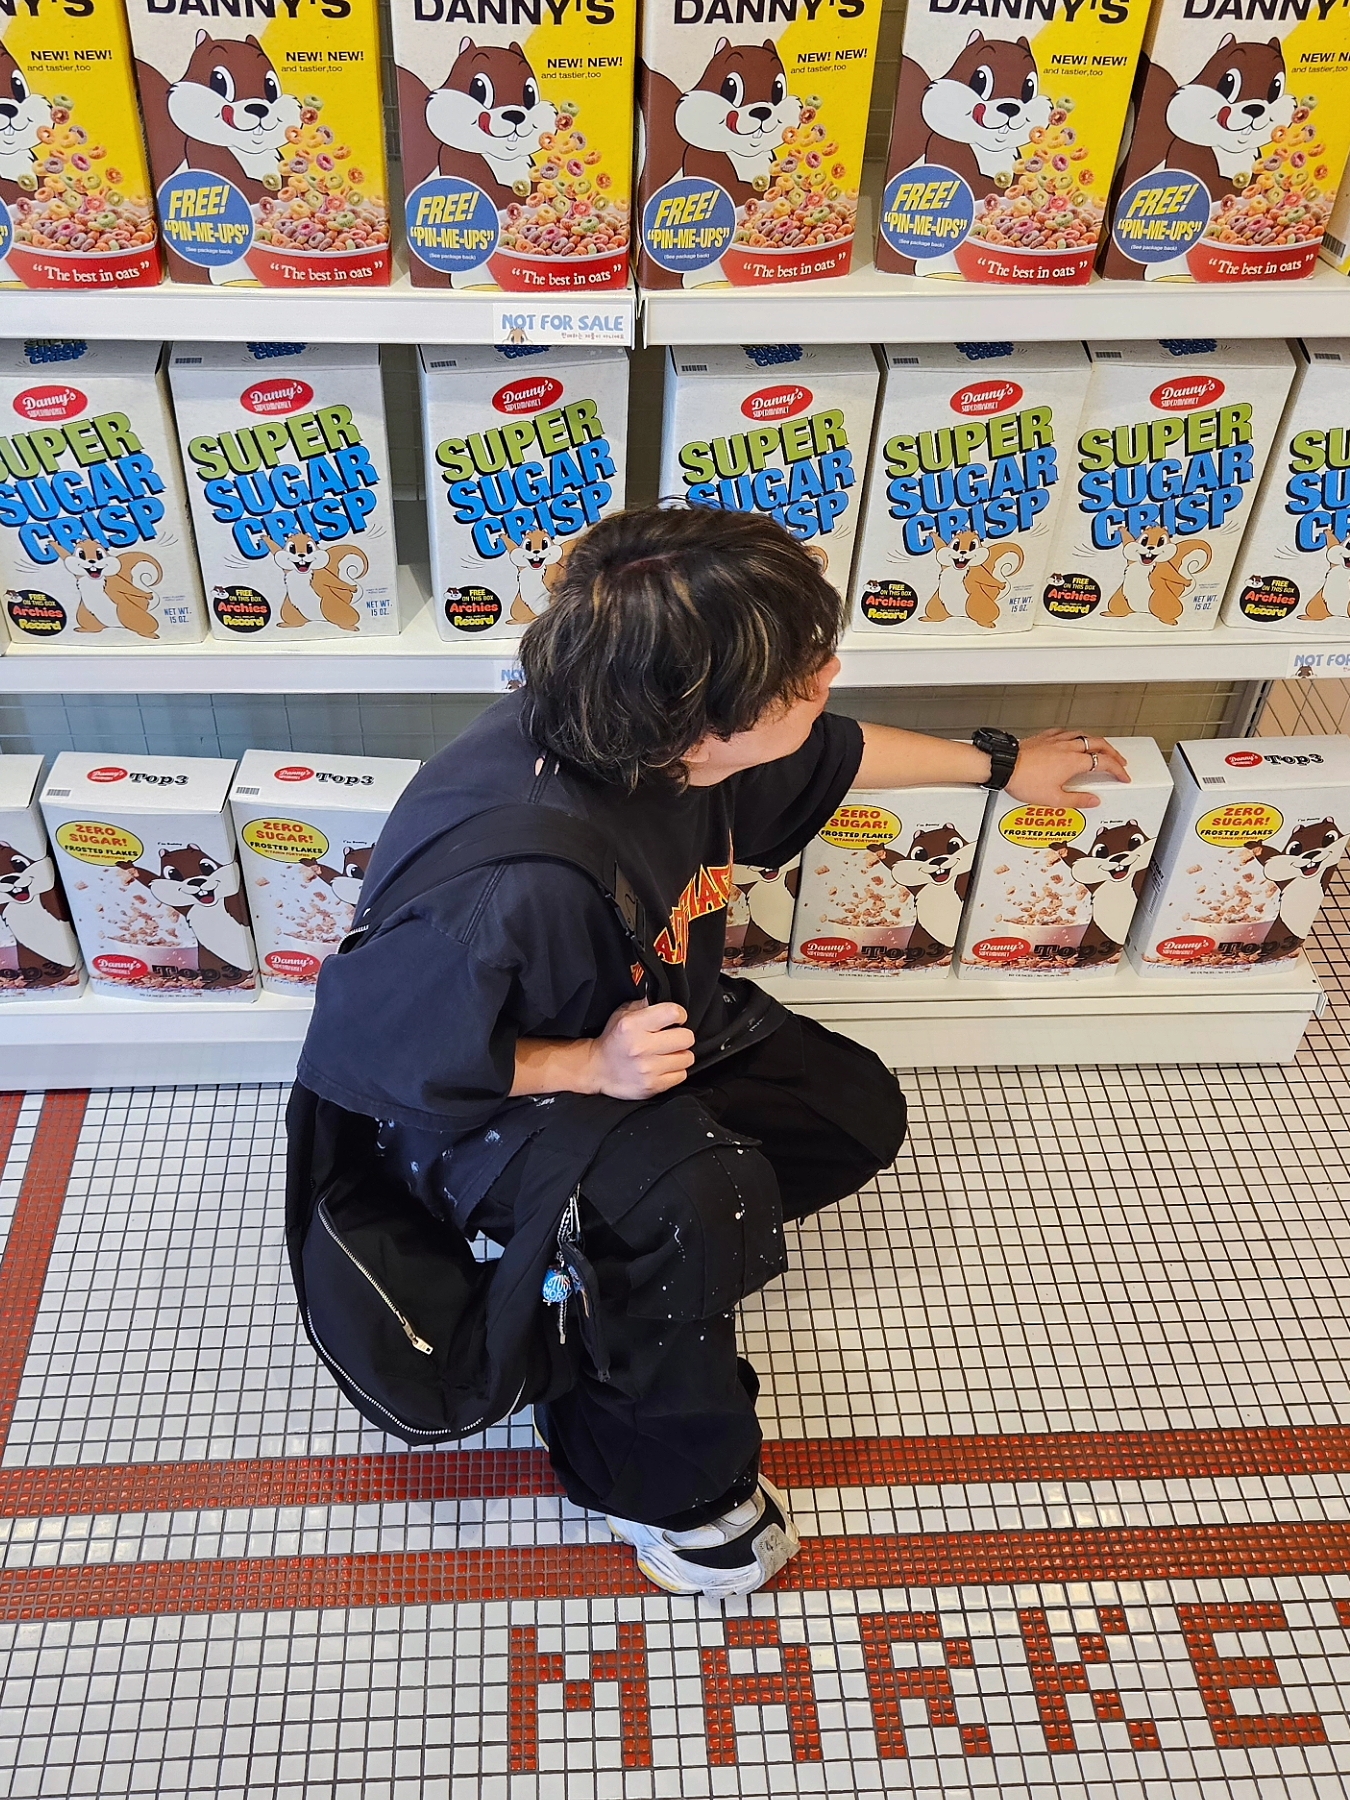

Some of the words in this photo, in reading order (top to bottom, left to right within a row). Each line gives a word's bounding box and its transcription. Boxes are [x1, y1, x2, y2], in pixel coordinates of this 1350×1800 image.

[146, 0, 351, 18] DANNY'S
[414, 0, 615, 25] DANNY'S
[673, 0, 865, 24] DANNY'S
[928, 0, 1128, 24] DANNY'S
[1182, 0, 1349, 20] DANNY'
[31, 51, 69, 61] NEW!
[74, 50, 112, 60] NEW!
[286, 51, 323, 62] NEW!
[328, 50, 364, 61] NEW!
[547, 58, 582, 68] NEW!
[588, 57, 622, 67] NEW!
[797, 53, 831, 63] NEW!
[835, 48, 867, 60] NEW!
[1051, 54, 1087, 65] NEW!
[1092, 56, 1127, 66] NEW!
[1300, 53, 1335, 63] NEW!
[27, 64, 43, 72] and
[169, 185, 230, 219] FREE!
[892, 180, 960, 212] FREE!
[1126, 183, 1199, 218] FREE!
[416, 191, 480, 225] FREE!
[654, 190, 720, 228] FREE!
[308, 268, 331, 282] best
[335, 268, 347, 280] in
[777, 264, 797, 277] best
[800, 262, 811, 275] in
[1013, 264, 1034, 279] best
[1037, 266, 1050, 279] in
[1241, 261, 1261, 275] best
[1265, 261, 1276, 274] in
[73, 269, 96, 282] best
[100, 269, 113, 281] in
[549, 271, 570, 285] best
[573, 271, 586, 284] in
[502, 314, 536, 330] NOT
[540, 315, 573, 330] FOR
[578, 315, 623, 331] SALE
[250, 383, 303, 405] Danny's
[502, 380, 554, 404] Danny's
[961, 384, 1014, 405] Danny's
[1161, 380, 1216, 400] Danny's
[22, 389, 76, 410] Danny's
[751, 388, 804, 411] Danny's
[188, 404, 363, 482] SUPER
[436, 399, 605, 483] SUPER
[883, 405, 1055, 479] SUPER
[1078, 402, 1253, 472] SUPER
[0, 411, 145, 483] UPER
[679, 409, 850, 485] SUPER
[204, 445, 380, 523] SUGAR
[448, 439, 617, 524] SUGAR
[687, 448, 856, 513] SUGAR
[886, 446, 1059, 519] SUGAR
[1078, 443, 1254, 512] SUGAR
[0, 453, 167, 527] SUGAR
[471, 481, 612, 559] CRISP
[771, 491, 849, 540] ISP
[903, 488, 1050, 556] CRISP
[1091, 486, 1243, 550] CRISP
[19, 497, 165, 565] CRISP
[232, 489, 377, 560] CRISP
[866, 595, 914, 607] Archies
[1048, 588, 1097, 602] Archies
[1245, 591, 1296, 605] Archies
[13, 605, 63, 617] Archies
[217, 601, 268, 613] Archies
[449, 602, 498, 613] Archies
[868, 608, 907, 619] Record
[1049, 601, 1090, 614] Record
[1244, 604, 1287, 617] Record
[19, 618, 61, 630] Record
[223, 615, 264, 626] Record
[454, 615, 494, 626] Record
[1294, 654, 1324, 667] NOT
[1263, 753, 1324, 766] Top3
[129, 772, 190, 786] Top3
[316, 772, 374, 787] Top3
[840, 809, 880, 819] ZERO
[1025, 807, 1066, 817] ZERO
[1224, 807, 1265, 817] ZERO
[263, 821, 303, 832] ZERO
[830, 819, 888, 829] SUGAR!
[1015, 817, 1072, 827] SUGAR!
[1212, 817, 1271, 827] SUGAR!
[75, 824, 116, 836] ZERO
[256, 830, 313, 844] SUGAR!
[1241, 828, 1273, 836] FLAKES
[69, 834, 127, 846] SUGAR!
[64, 845, 104, 855] FROSTED
[106, 848, 138, 857] FLAKES
[250, 841, 288, 851] FROSTED
[291, 844, 322, 854] FLAKES
[808, 942, 852, 952] Danny's
[980, 941, 1024, 951] Danny's
[1164, 939, 1209, 950] Danny's
[98, 959, 142, 970] Danny's
[270, 955, 314, 967] Danny's
[510, 1601, 1350, 1770] MARKE
